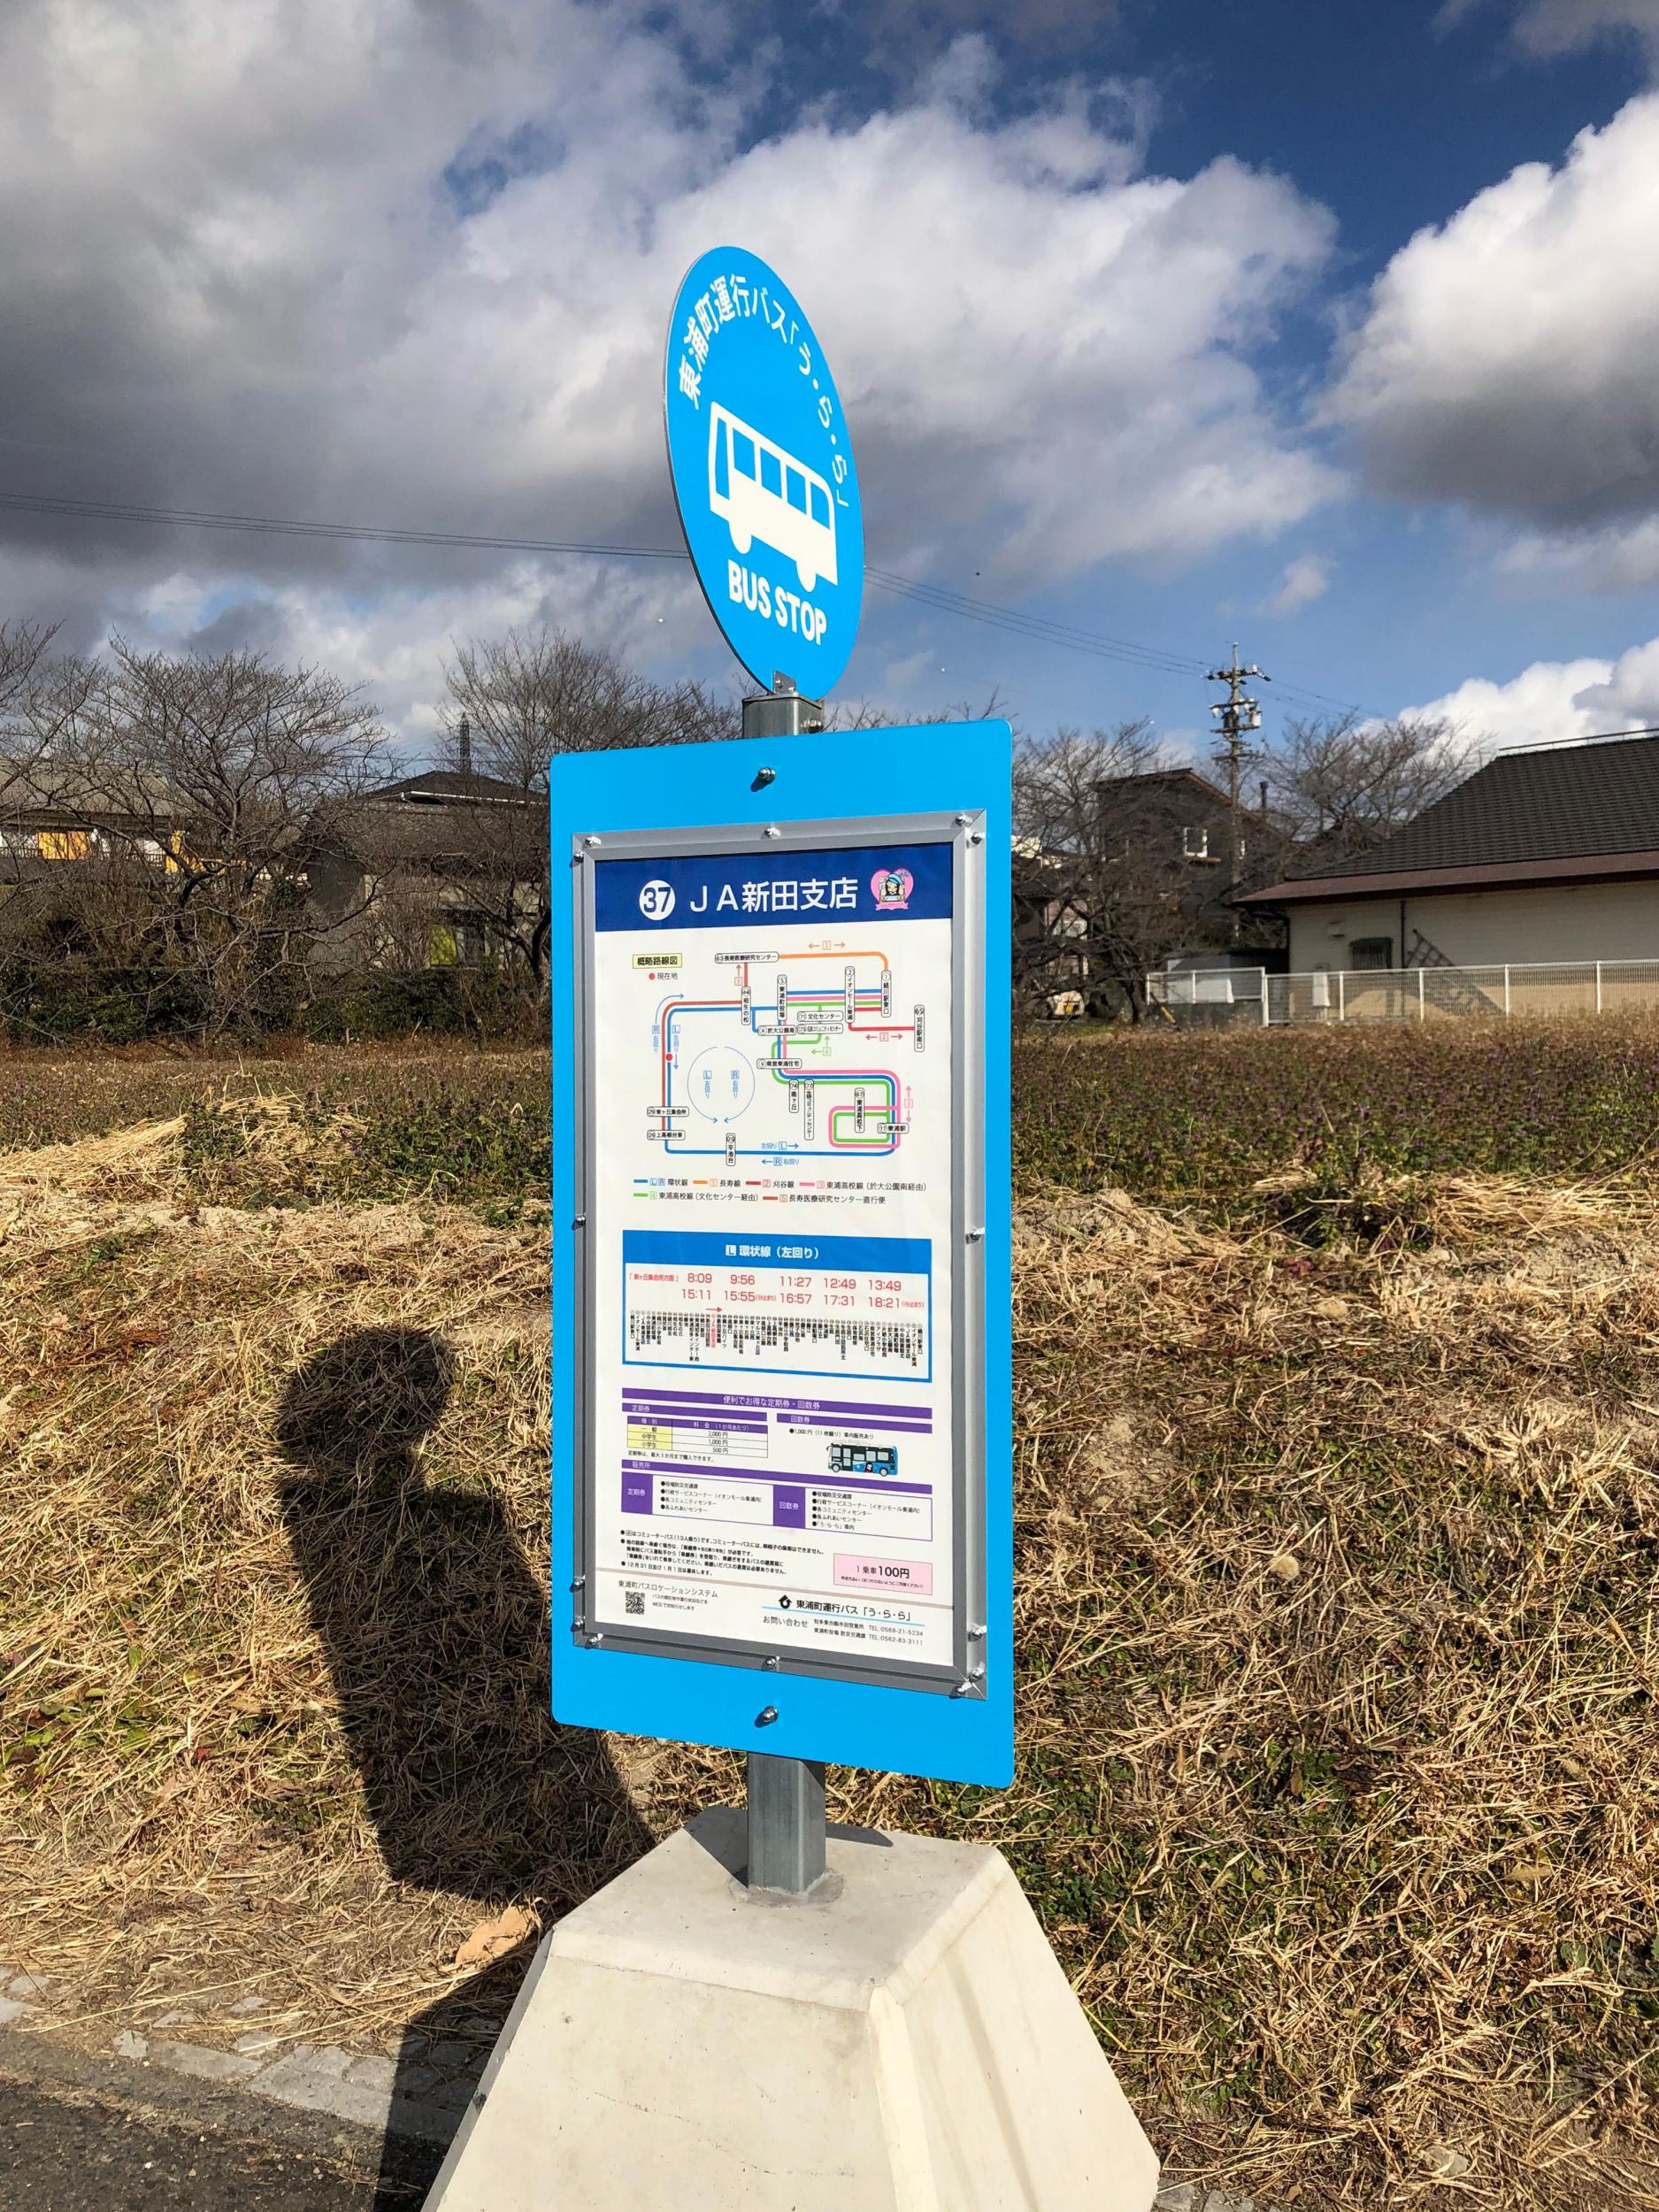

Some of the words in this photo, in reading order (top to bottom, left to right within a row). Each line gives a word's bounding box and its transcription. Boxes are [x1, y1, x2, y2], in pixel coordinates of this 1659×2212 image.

[727, 558, 772, 619] BUS
[775, 585, 828, 646] STOP
[642, 886, 672, 913] 37
[637, 956, 678, 965] 概略路線図
[687, 1273, 712, 1284] 8:09
[730, 1274, 756, 1286] 9:56
[780, 1276, 812, 1288] 11:27
[824, 1278, 856, 1289] 12:49
[868, 1279, 902, 1291] 13:49
[682, 1288, 712, 1301] 15:11
[724, 1291, 756, 1302] 15:55
[780, 1294, 812, 1305] 16:57
[824, 1294, 855, 1307] 17:31
[868, 1296, 900, 1309] 18:21
[723, 1395, 820, 1409] 便利でお得な定期券・回数券
[618, 1580, 718, 1598] 東浦町バスロケーションシステム
[763, 1615, 809, 1628] お問い合わせ
